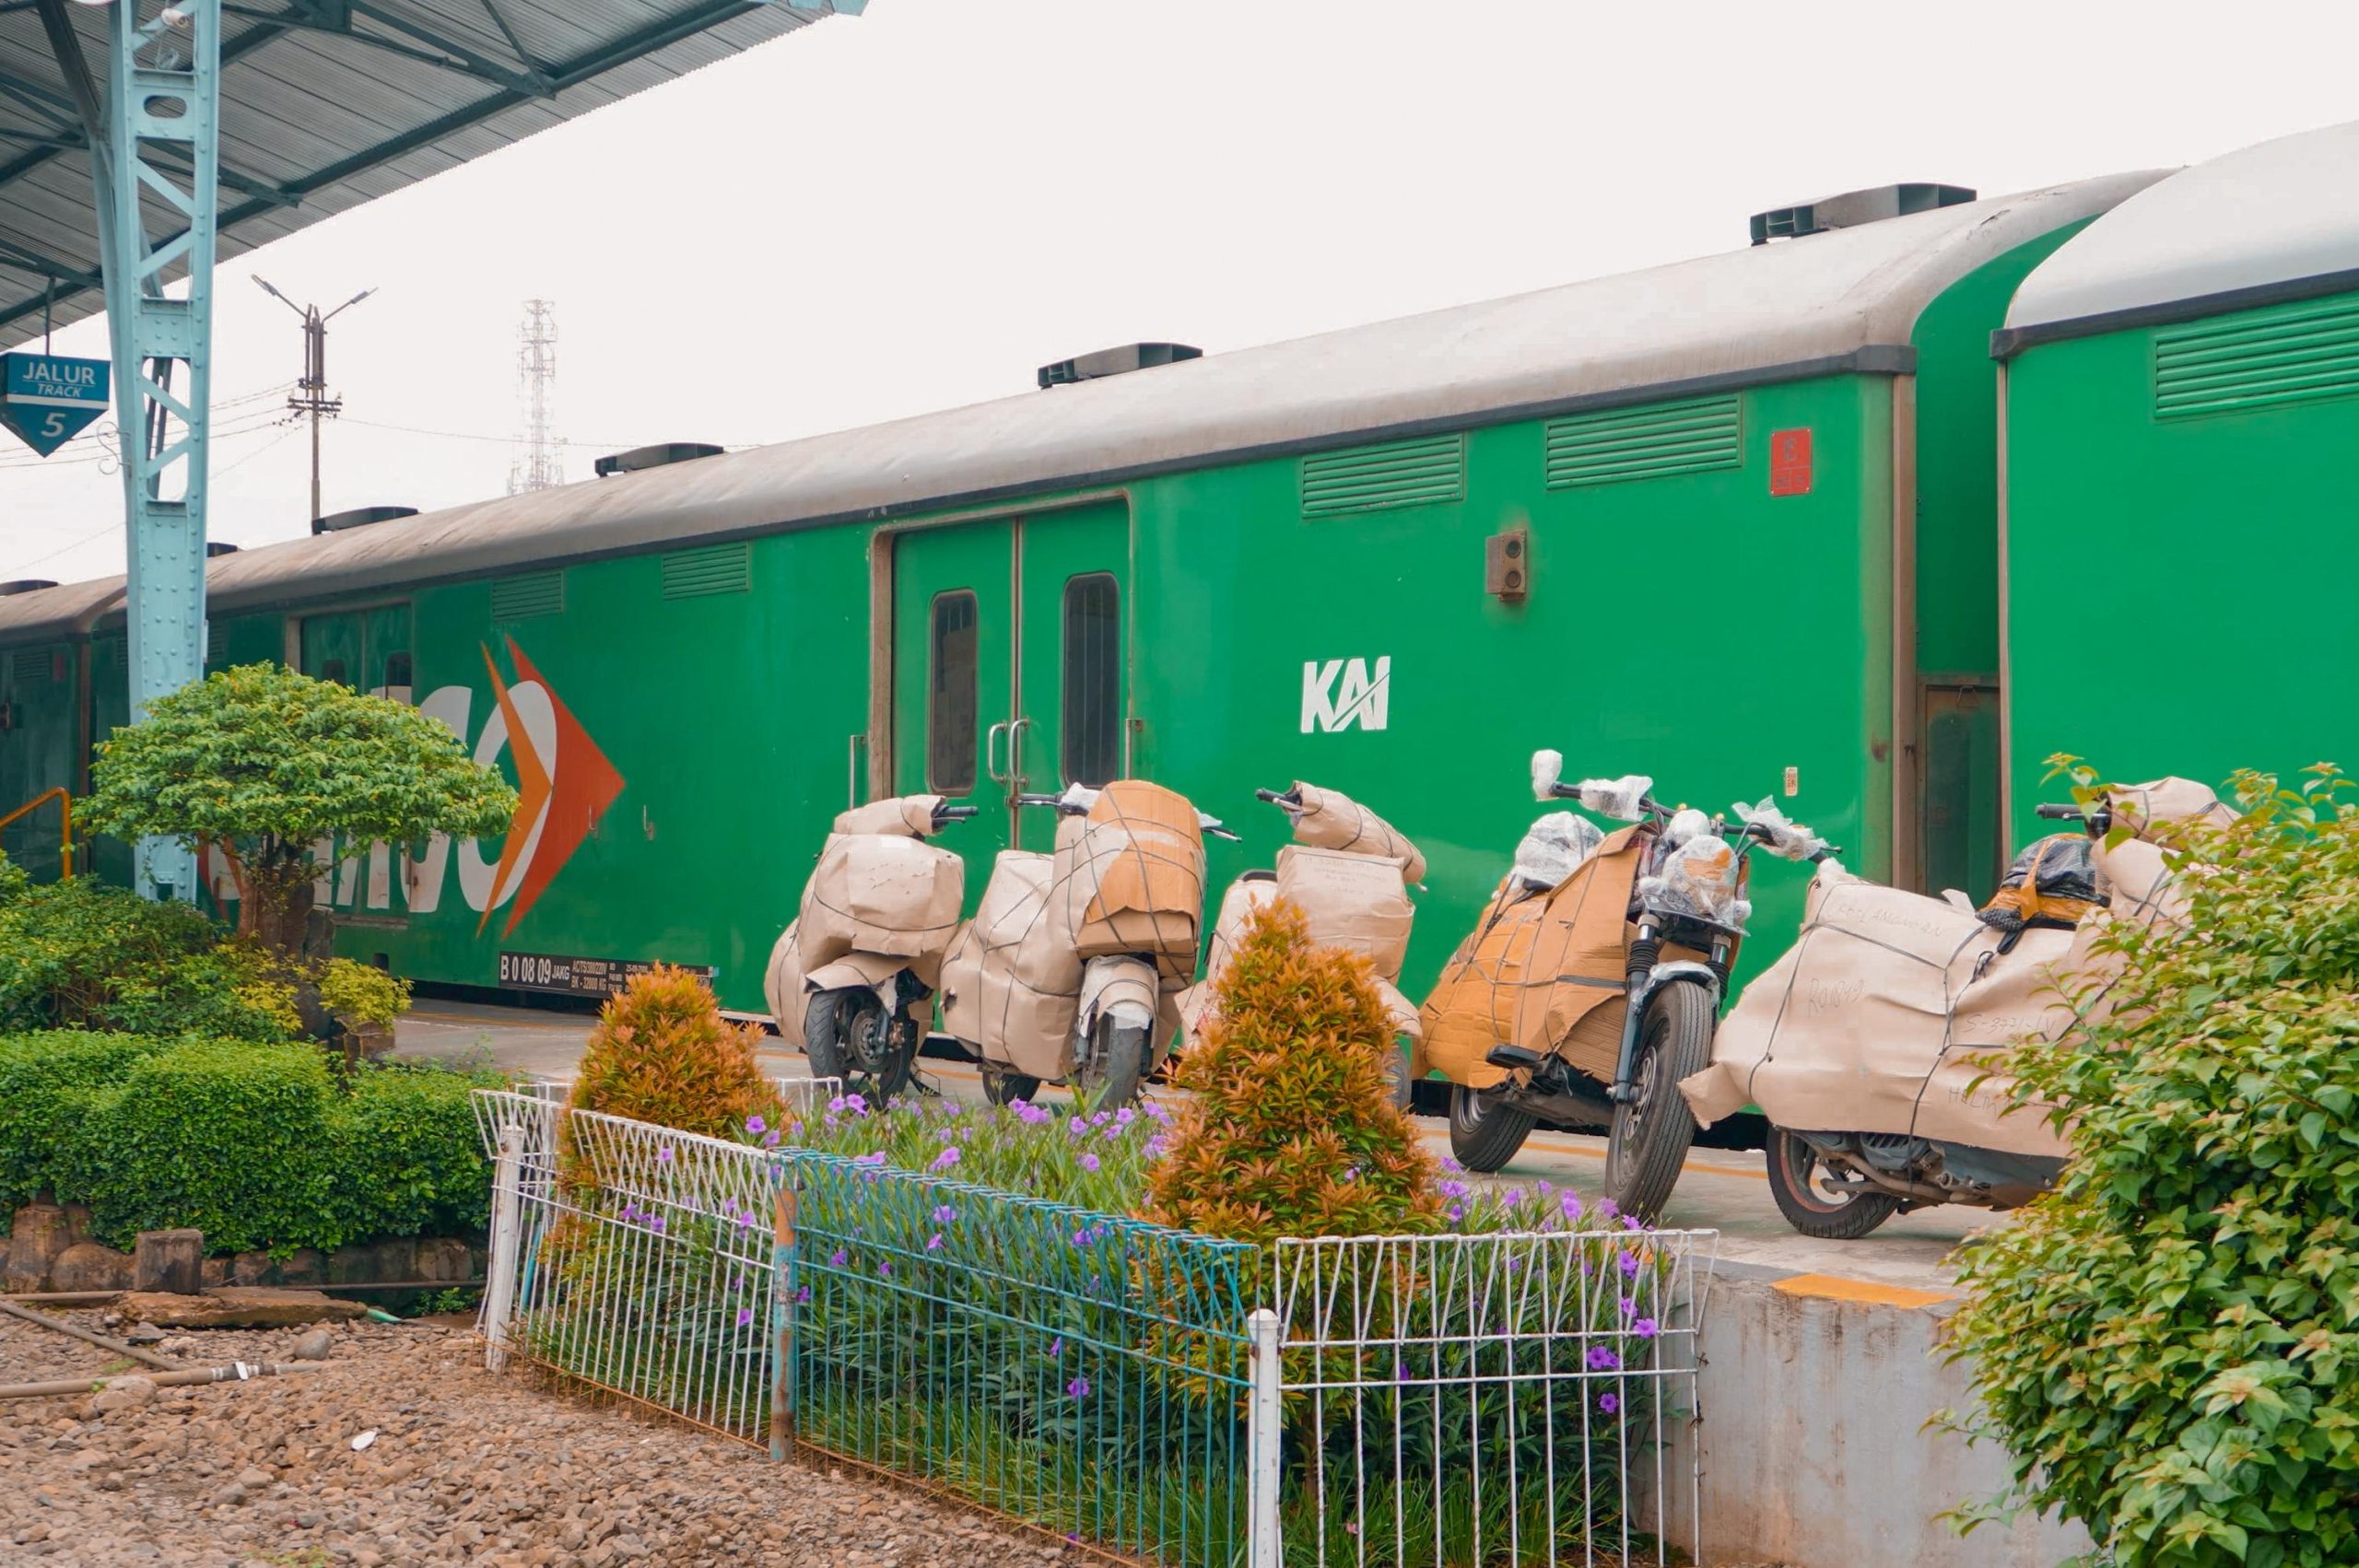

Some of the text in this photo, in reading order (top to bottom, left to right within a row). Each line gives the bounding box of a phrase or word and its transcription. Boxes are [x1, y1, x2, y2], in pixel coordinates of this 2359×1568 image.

[22, 361, 96, 385] JALUR
[37, 383, 83, 398] TRACK
[41, 412, 66, 438] 5
[1300, 655, 1391, 733] KAI
[500, 955, 510, 980] B
[522, 957, 535, 983] 08
[537, 958, 552, 984] 09
[552, 965, 570, 980] JAKG
